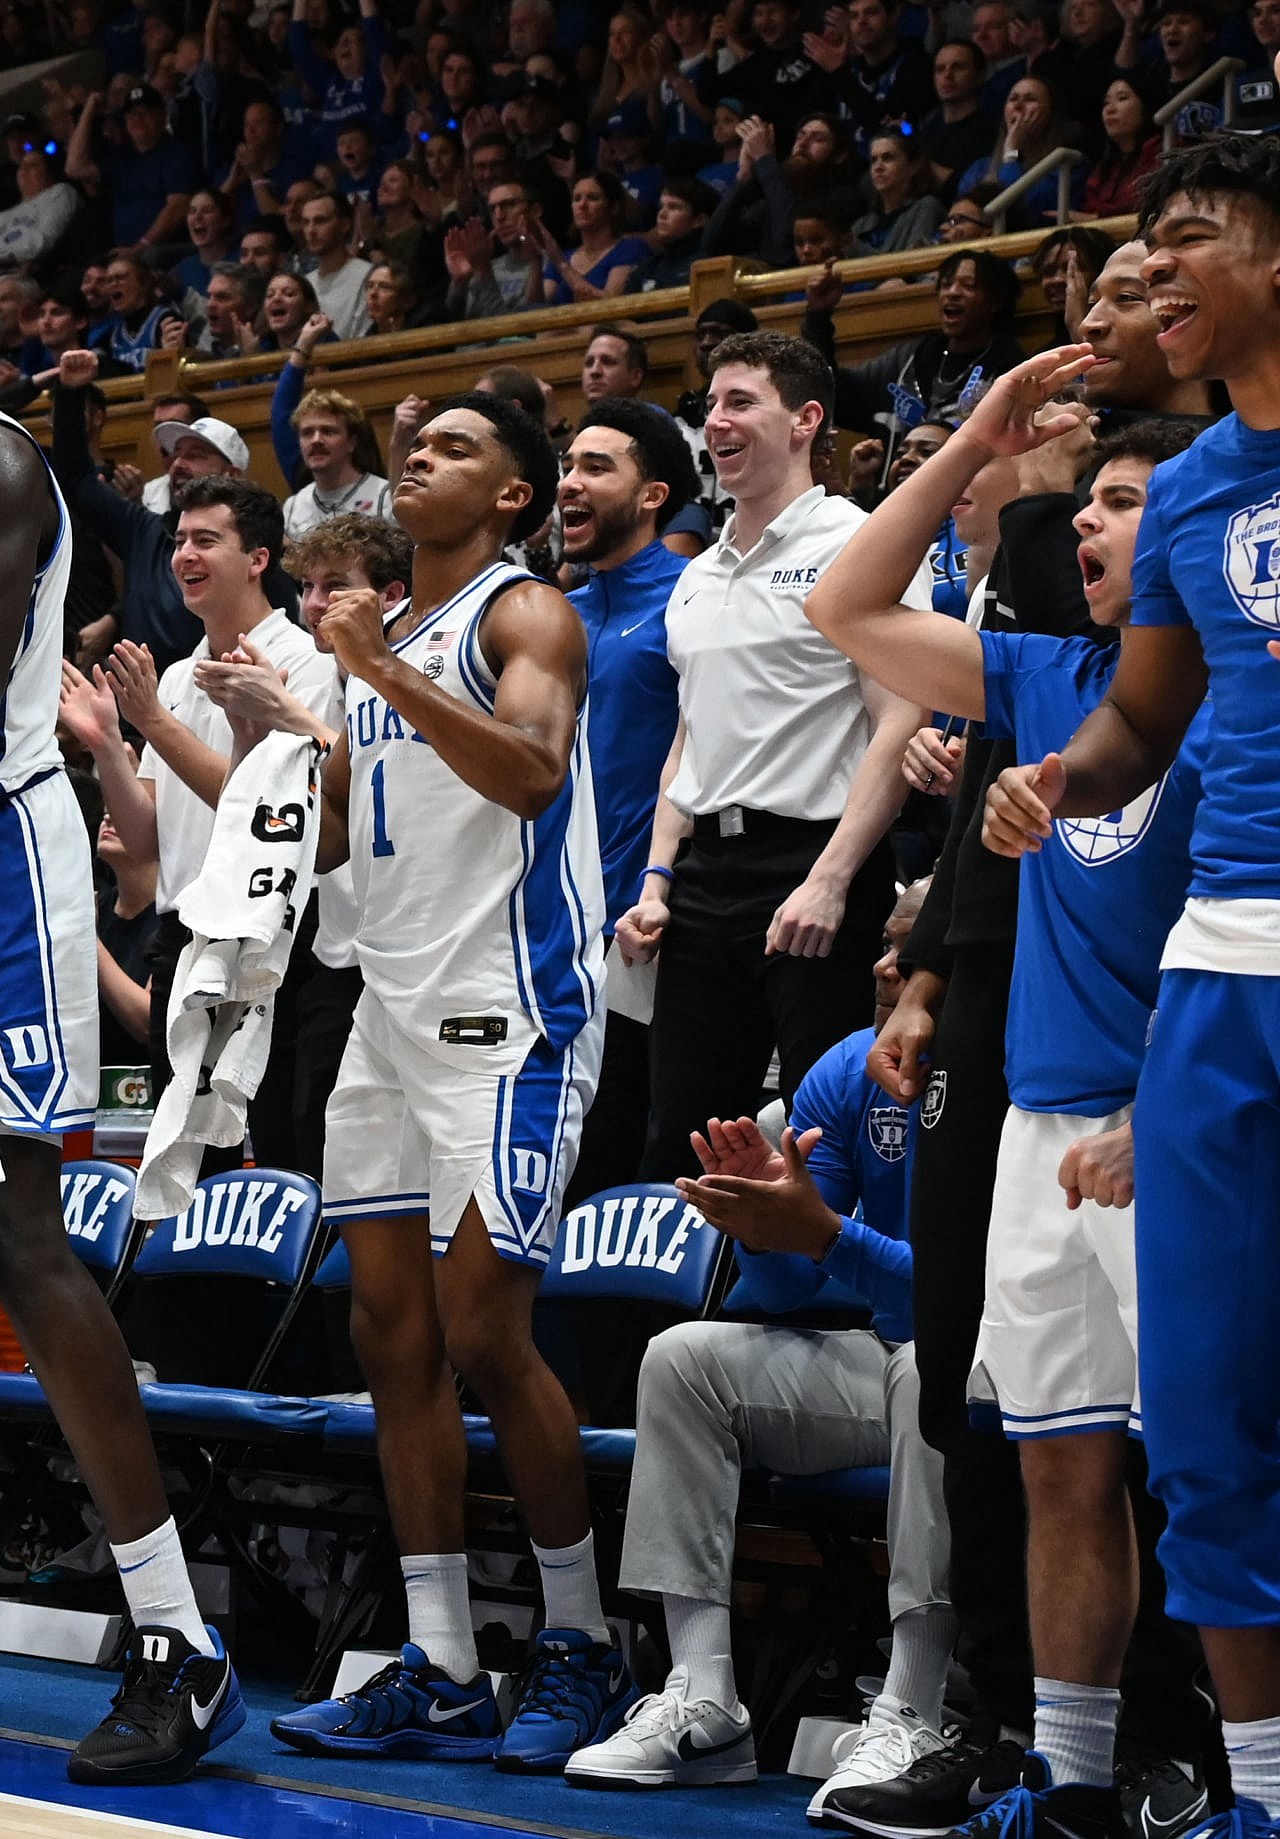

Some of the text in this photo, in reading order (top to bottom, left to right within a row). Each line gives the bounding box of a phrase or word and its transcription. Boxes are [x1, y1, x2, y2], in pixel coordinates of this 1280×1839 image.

[1235, 528, 1255, 545] THE
[771, 568, 818, 584] DUKE
[371, 759, 395, 857] 1
[3, 1024, 49, 1069] D
[489, 1023, 502, 1033] 50
[511, 1147, 547, 1194] D
[172, 1181, 309, 1254] DUKE
[561, 1196, 706, 1274] DUKE
[142, 1634, 170, 1662] D
